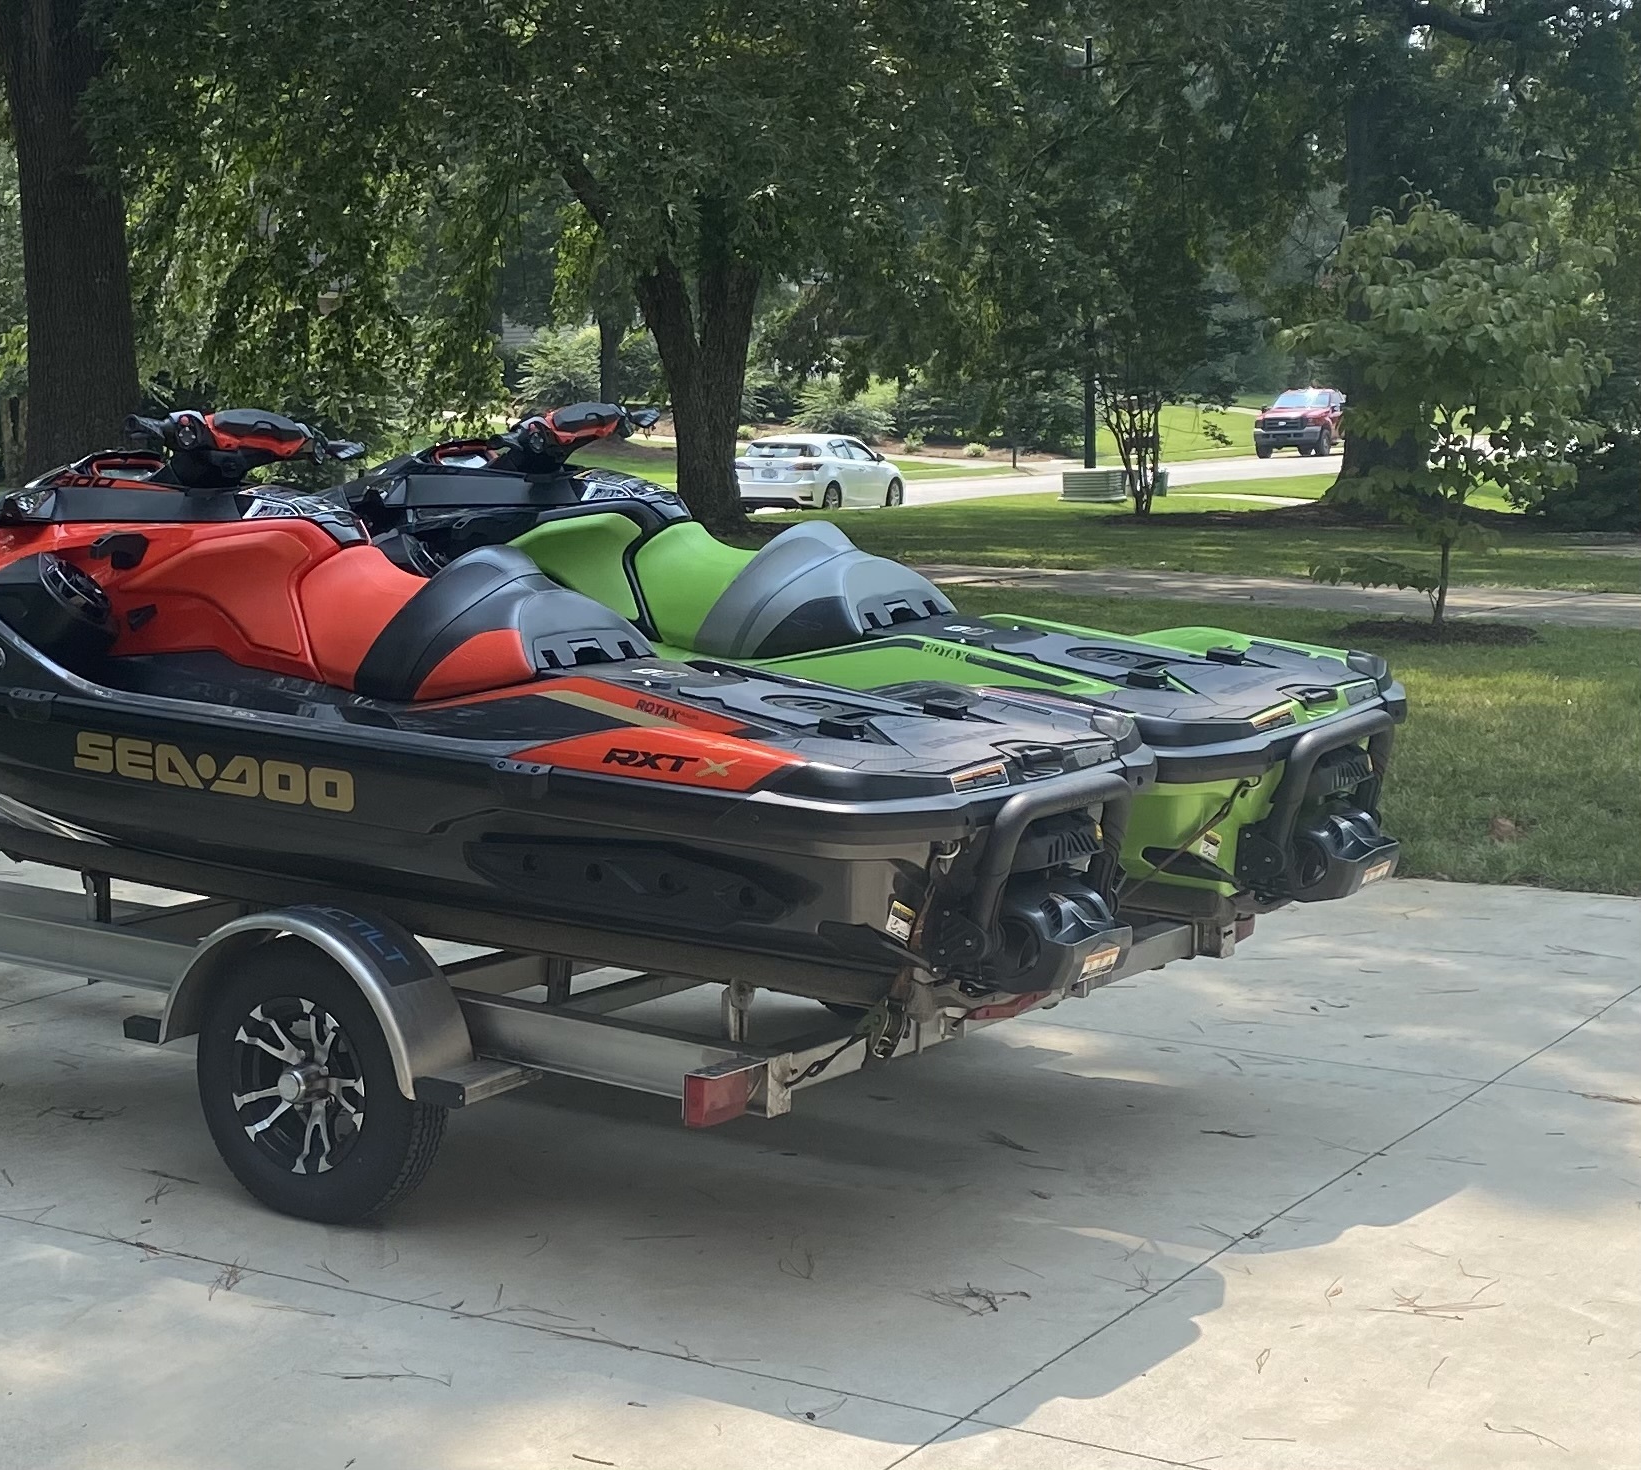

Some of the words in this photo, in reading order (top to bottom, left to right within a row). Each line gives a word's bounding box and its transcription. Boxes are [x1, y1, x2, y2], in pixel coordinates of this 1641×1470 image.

[921, 641, 971, 662] ROTAX
[635, 699, 681, 722] ROTAX
[601, 747, 701, 773] RXT
